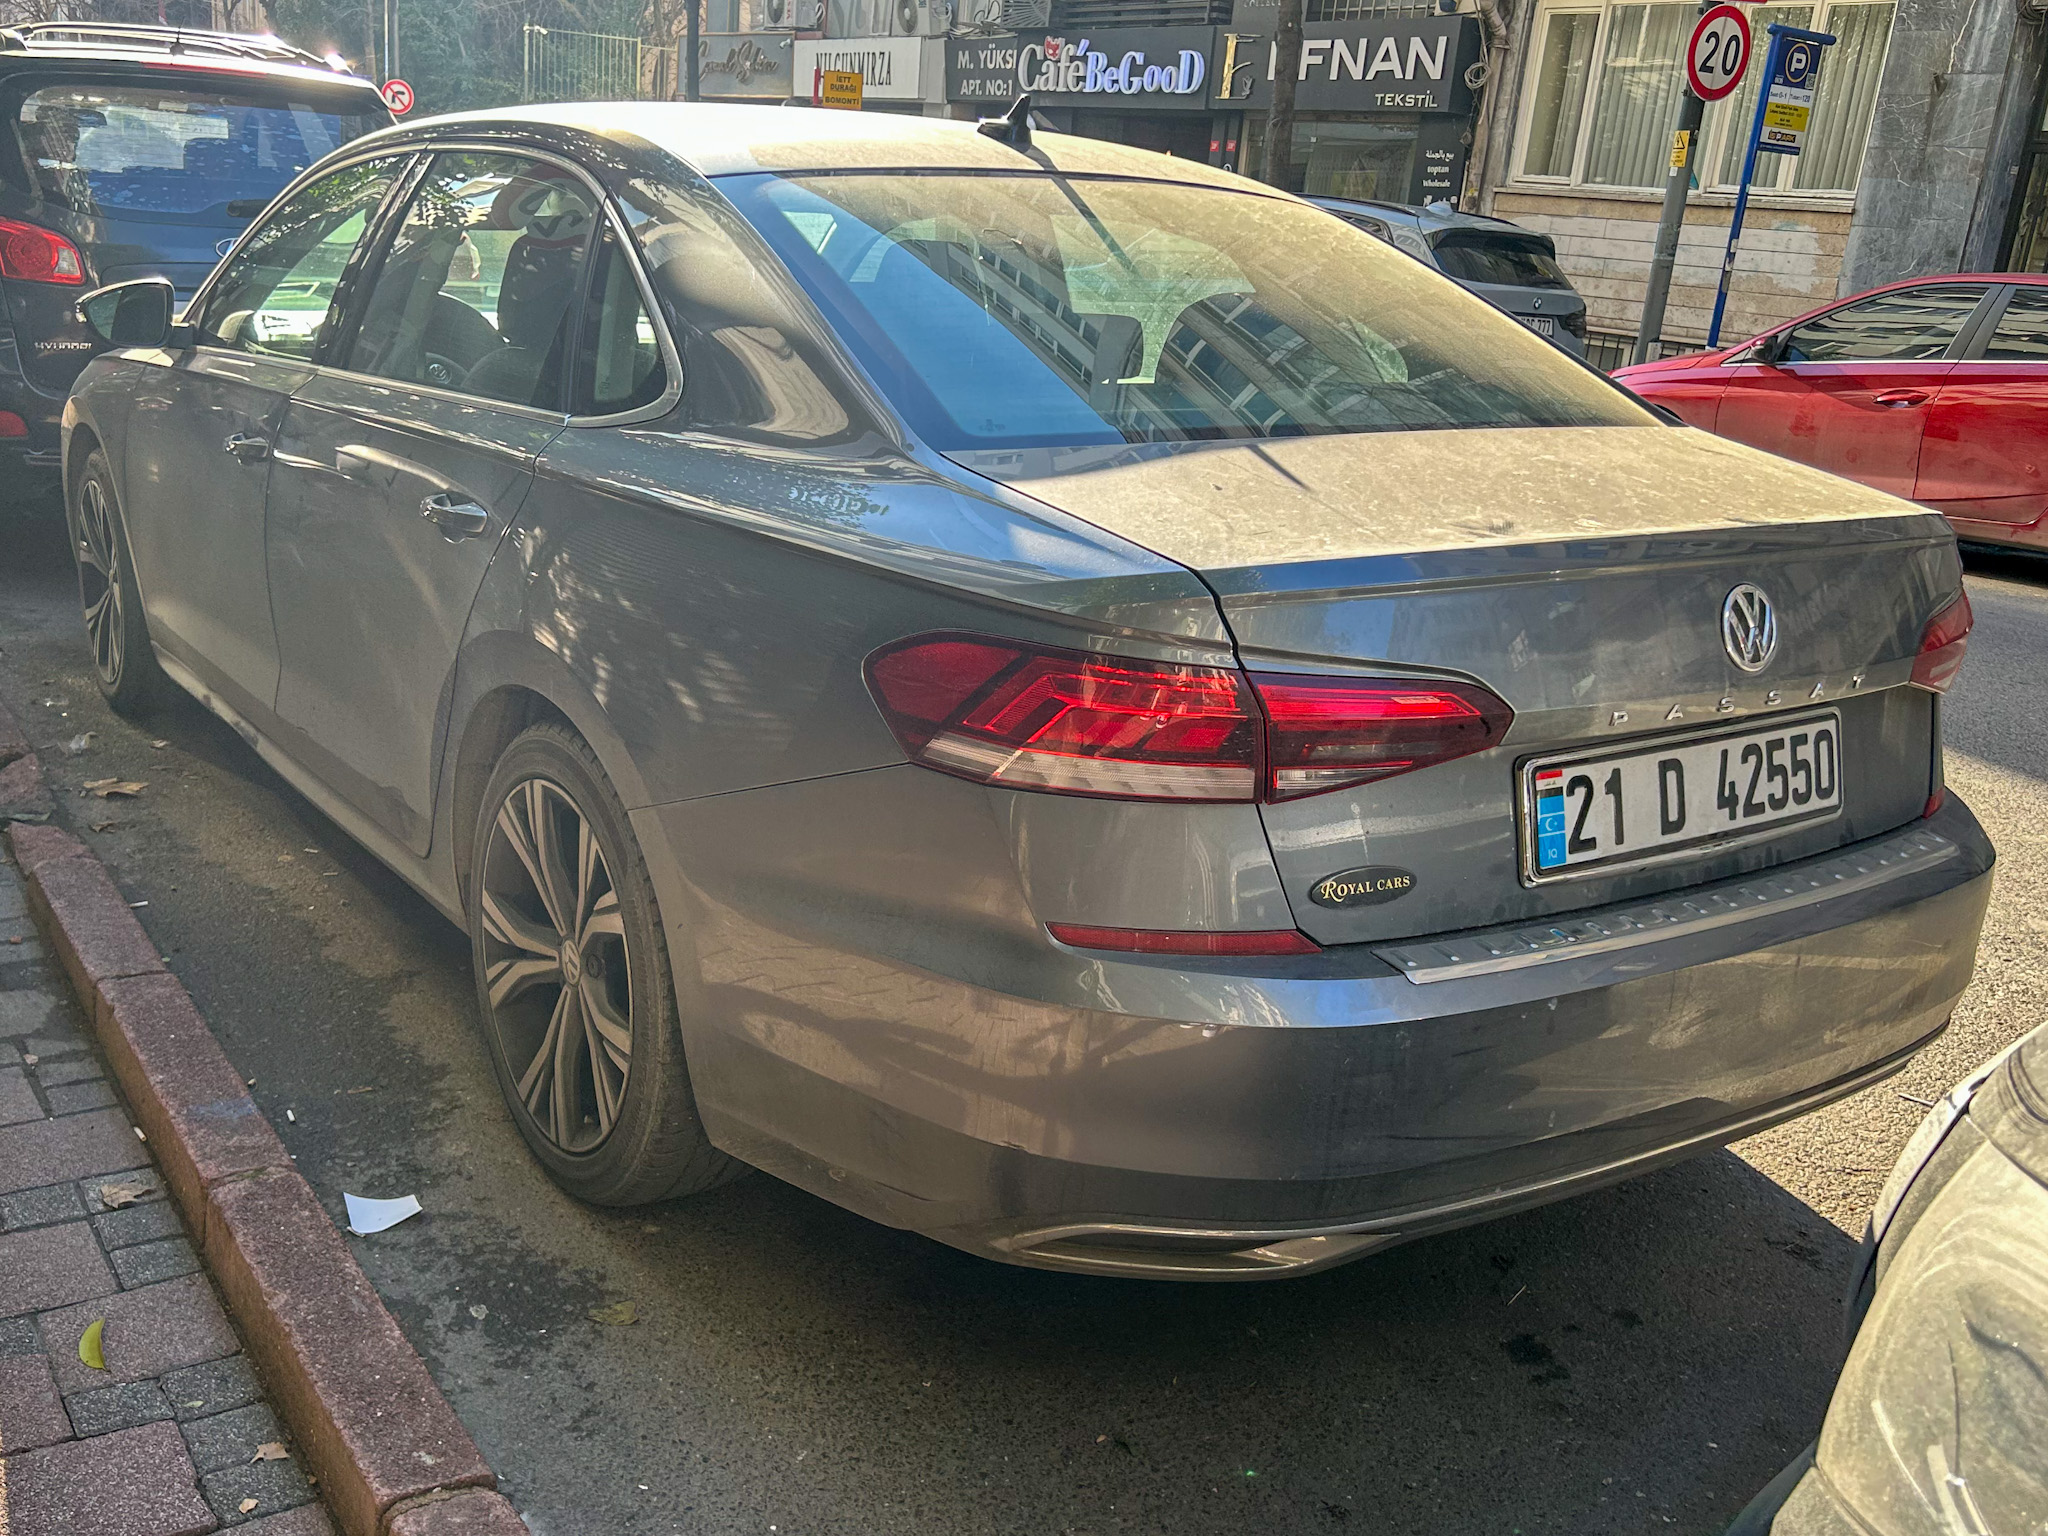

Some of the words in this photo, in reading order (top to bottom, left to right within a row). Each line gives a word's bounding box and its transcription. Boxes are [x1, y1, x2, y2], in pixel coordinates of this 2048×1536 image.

[957, 50, 974, 69] M.
[1267, 36, 1448, 81] FNAN
[1699, 31, 1741, 76] 20
[825, 95, 860, 105] BOMONTİ
[960, 79, 982, 96] APT.
[1375, 90, 1438, 108] TEKSTİL
[1608, 674, 1866, 727] PASSAT
[1566, 767, 1625, 855] 21
[1658, 757, 1687, 837] D
[1717, 729, 1835, 822] 42550
[1321, 881, 1374, 902] ROYAL
[1376, 875, 1411, 891] CARS
